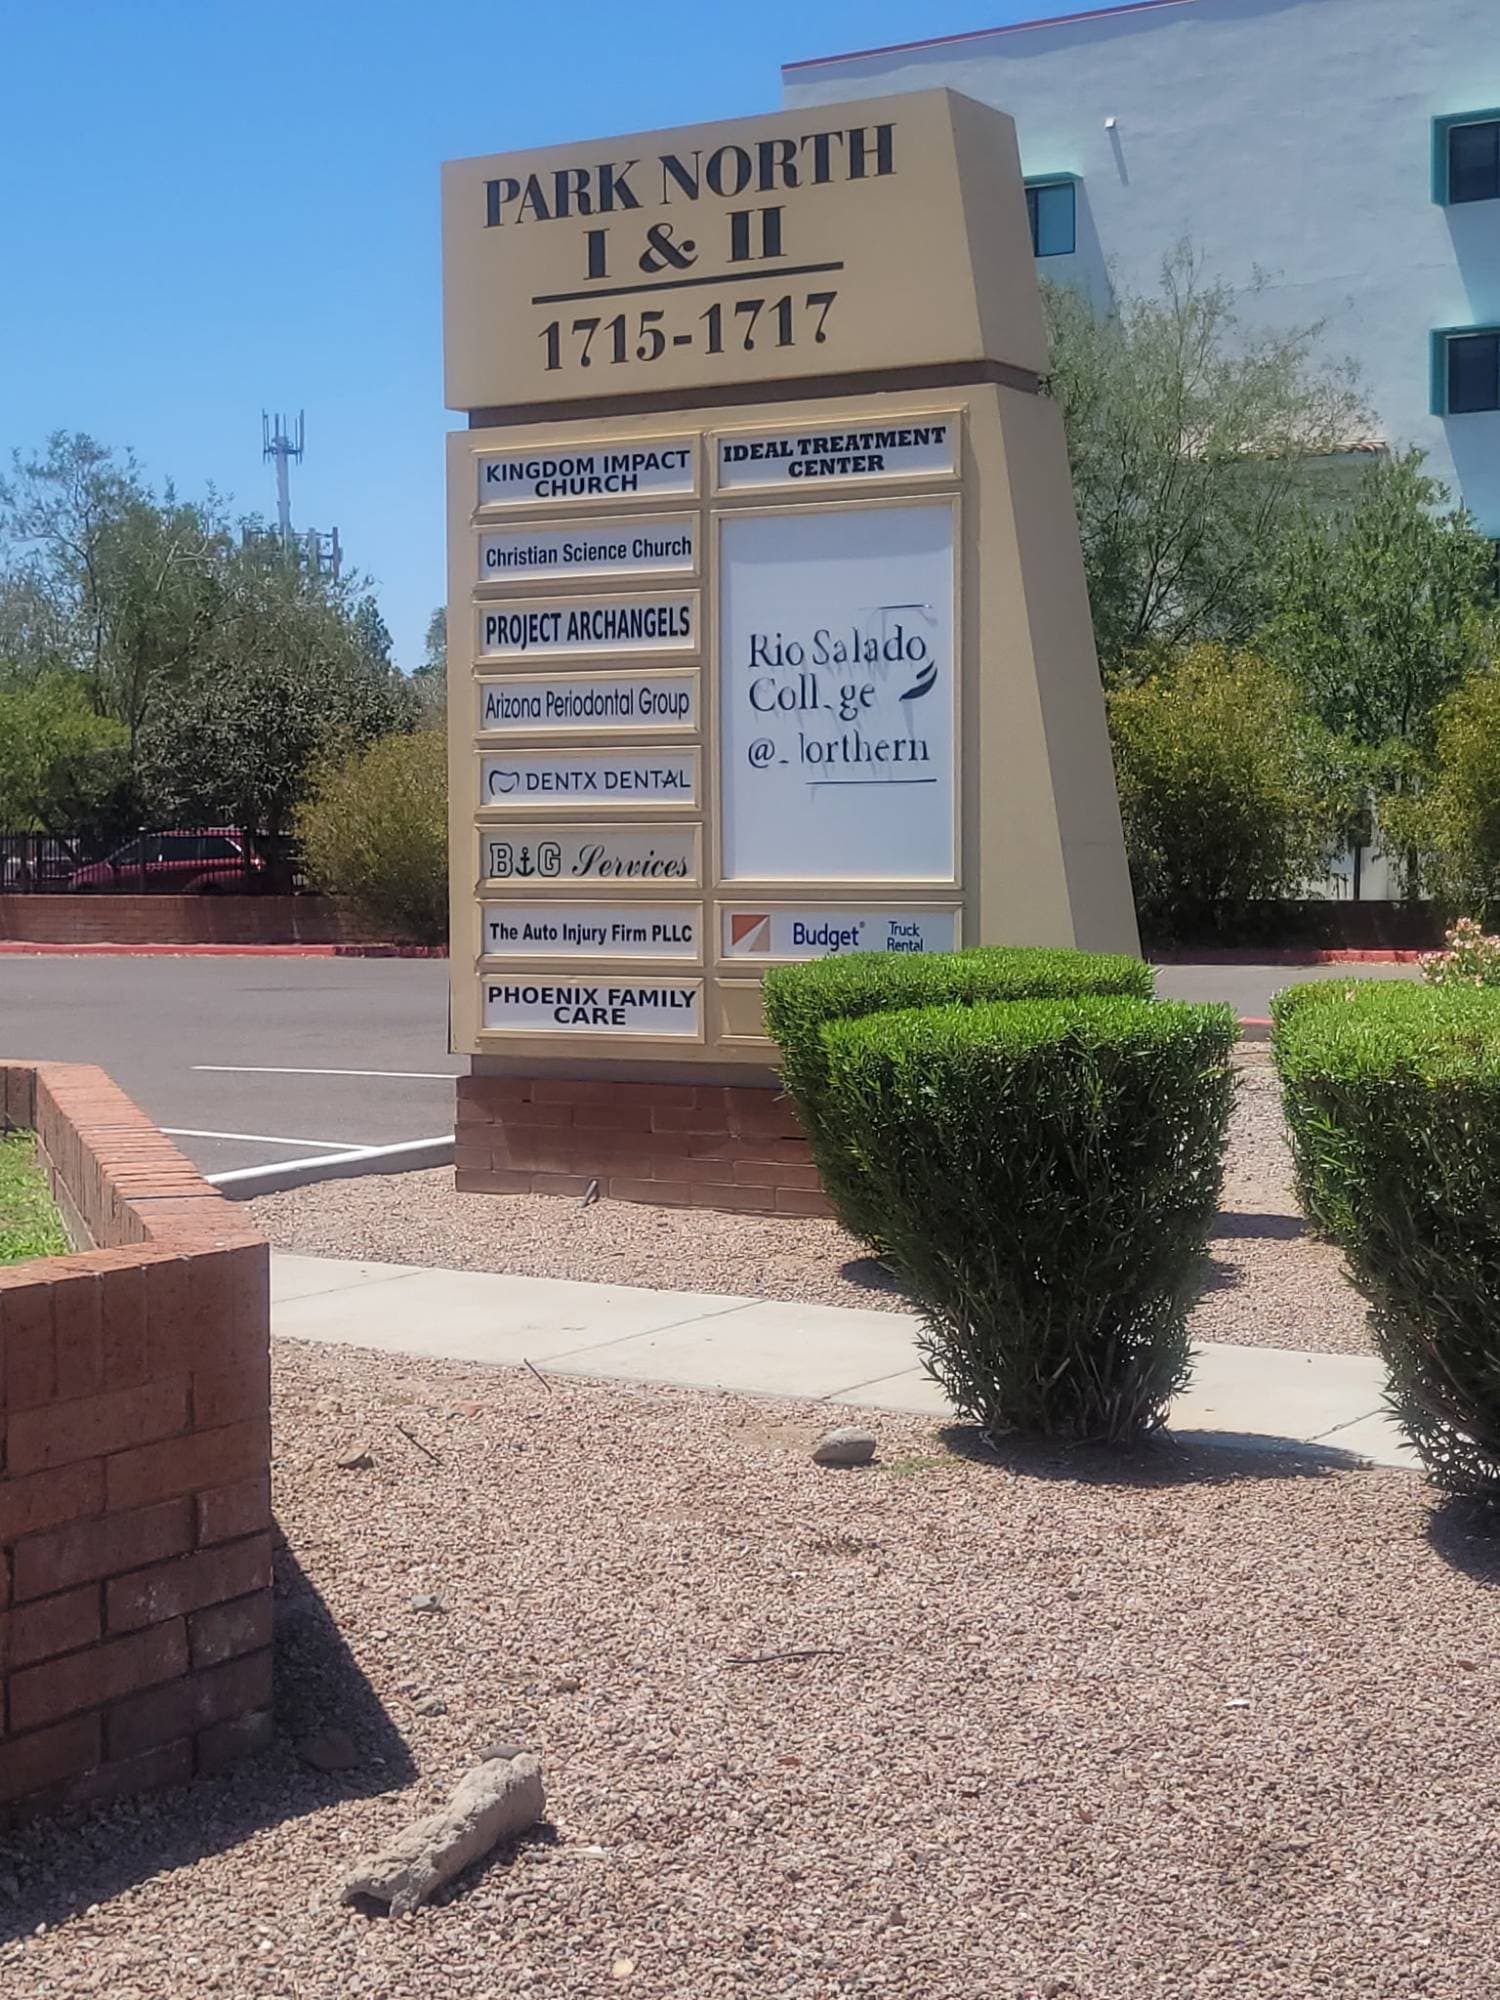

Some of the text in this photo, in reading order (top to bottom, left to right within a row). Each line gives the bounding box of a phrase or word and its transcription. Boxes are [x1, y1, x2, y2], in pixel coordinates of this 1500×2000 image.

[483, 123, 897, 228] PARK NORTH
[583, 206, 787, 280] I & II
[537, 290, 838, 371] 1715-1717
[723, 426, 946, 462] IDEAL TREATMENT
[486, 450, 690, 482] KINGDOM IMPACT
[788, 455, 884, 477] CENTER
[535, 474, 638, 497] CHURCH
[486, 536, 691, 567] Christian Science Church
[486, 606, 689, 650] PROJECT ARCHANGELS
[749, 624, 926, 668] Rio Salado
[485, 688, 689, 720] Arizona Periodontal Group
[749, 673, 875, 721] Collge
[526, 770, 691, 790] DENTX DENTAL
[571, 844, 689, 878] Services
[490, 923, 692, 945] The Auto Injury Firm PLLC
[887, 937, 923, 952] Rental
[888, 921, 919, 936] Truck
[488, 986, 696, 1008] PHOENIX FAMILY
[554, 1007, 626, 1025] CARE
